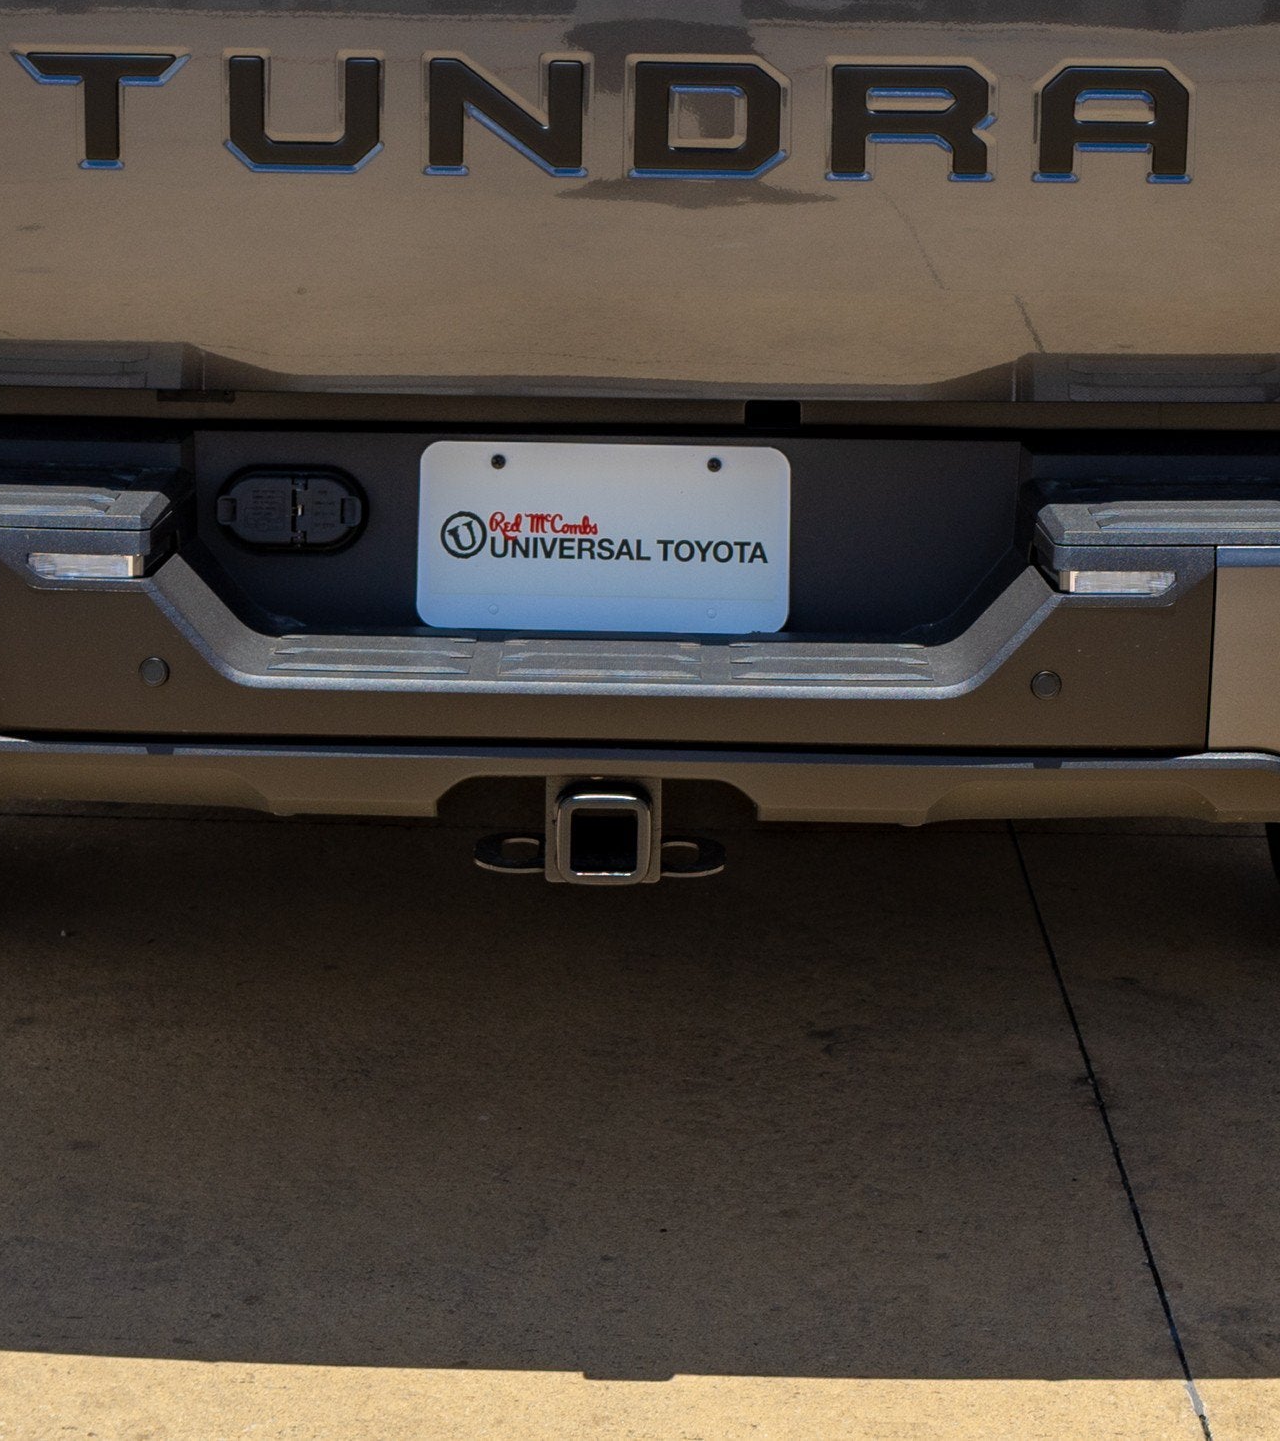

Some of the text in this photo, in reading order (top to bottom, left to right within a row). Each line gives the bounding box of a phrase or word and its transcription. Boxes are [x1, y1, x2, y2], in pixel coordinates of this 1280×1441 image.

[10, 48, 1194, 184] TUNDRA
[489, 511, 523, 541] Red
[489, 536, 768, 564] UNIVERSAL TOYOTA
